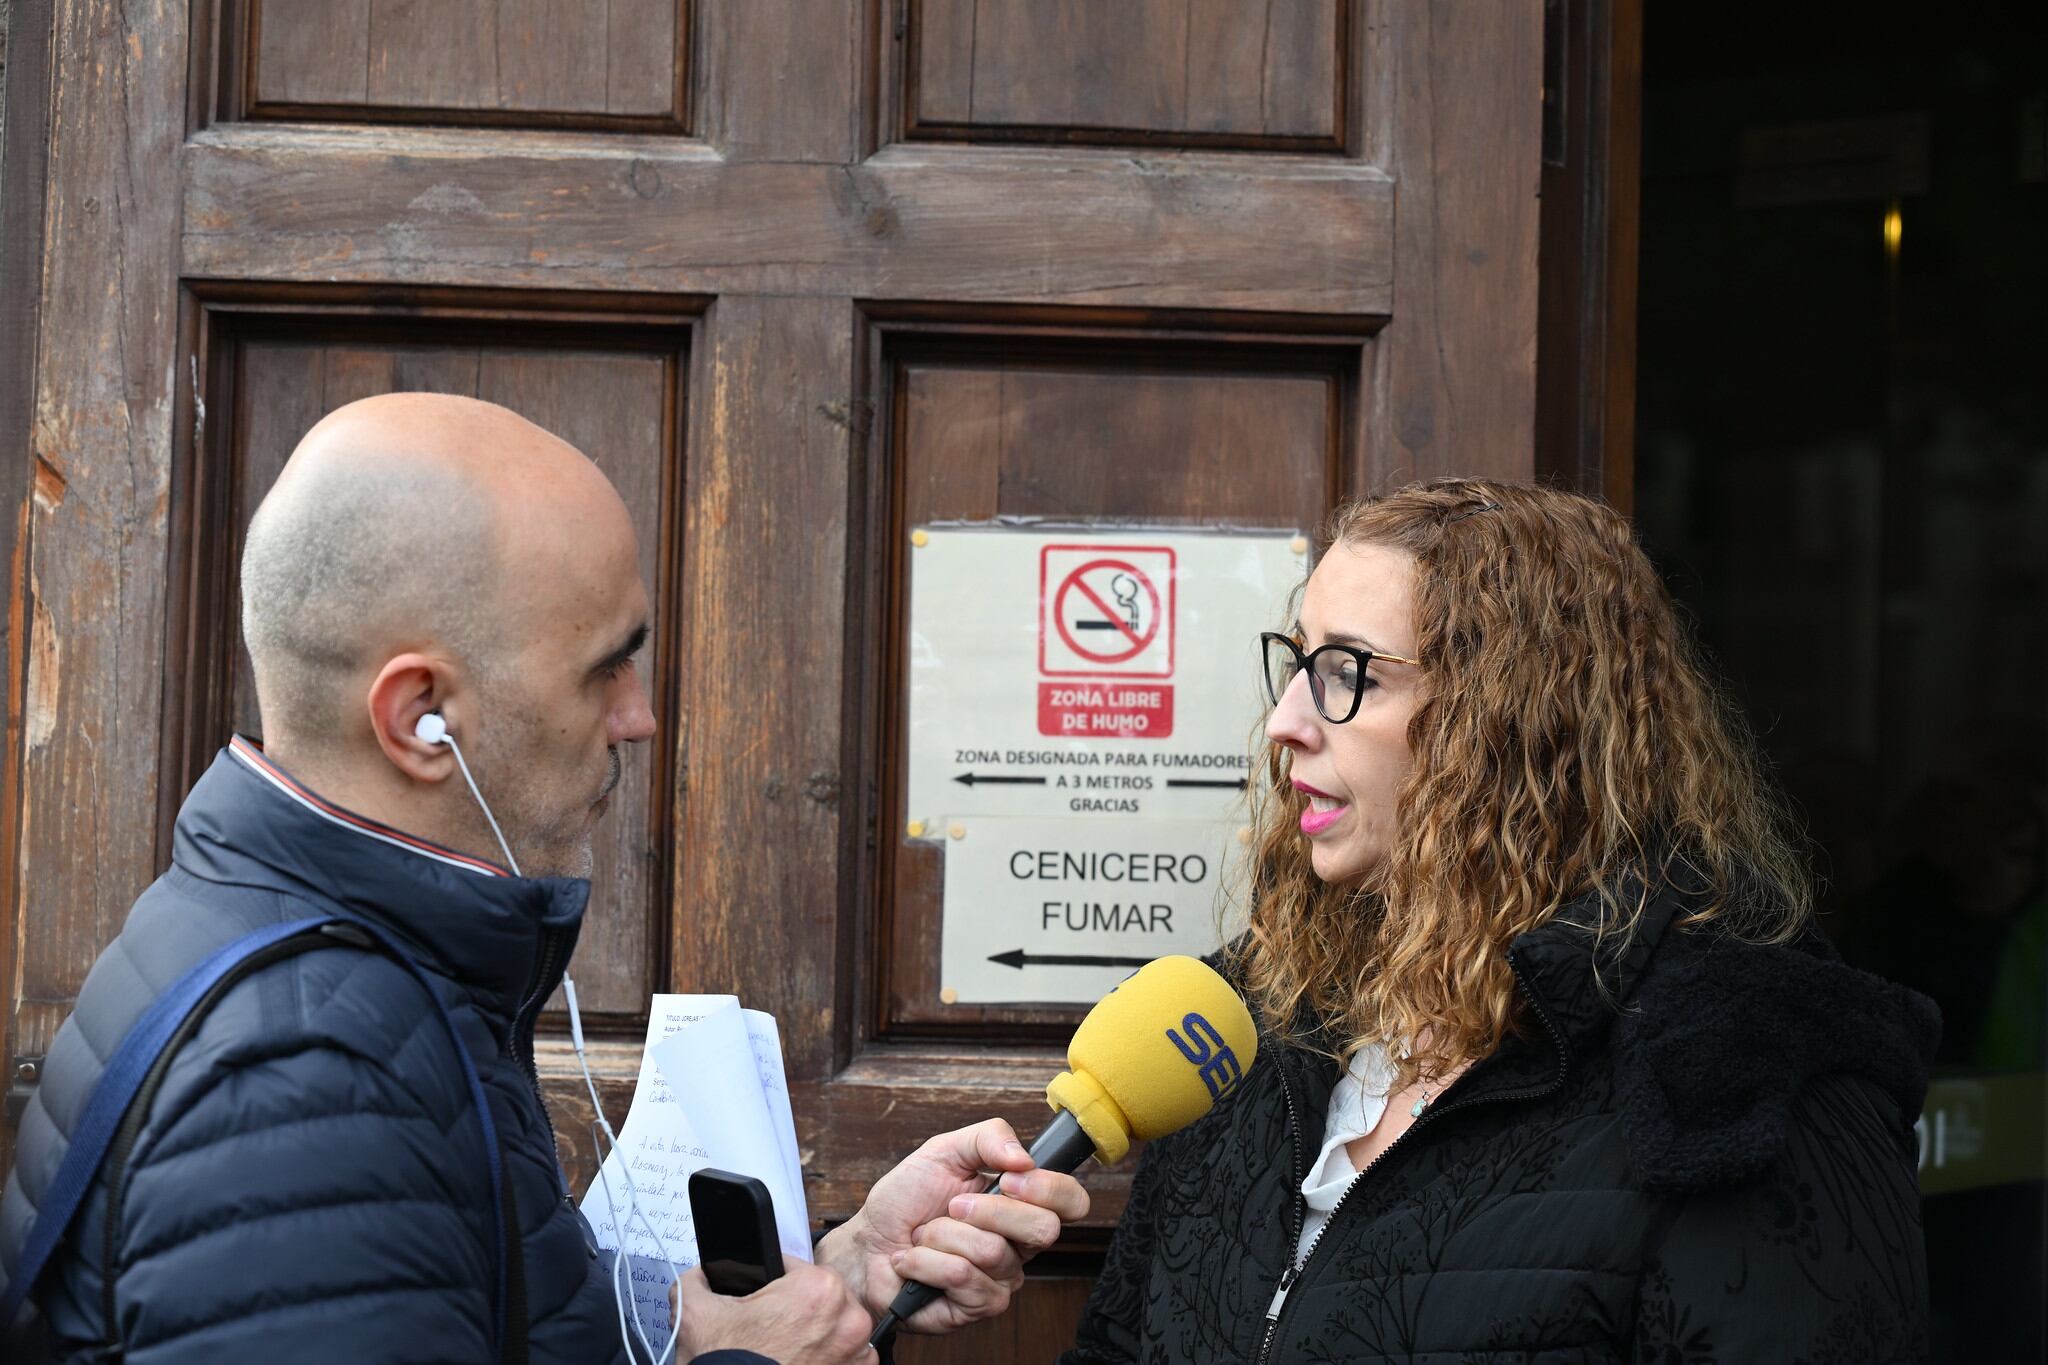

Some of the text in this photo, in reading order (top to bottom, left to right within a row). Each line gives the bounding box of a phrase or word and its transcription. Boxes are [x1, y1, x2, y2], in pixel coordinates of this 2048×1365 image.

[1050, 690, 1161, 709] ZONA LIBRE
[1062, 713, 1149, 732] DE HUMO
[955, 750, 1254, 769] ZONA DESIGNADA PARA FUMADORES
[1055, 774, 1154, 790] A 3 METROS
[1069, 798, 1140, 813] GRACIAS
[1009, 851, 1208, 883] CENICERO
[1042, 902, 1174, 933] FUMAR
[1165, 1012, 1243, 1101] SE
